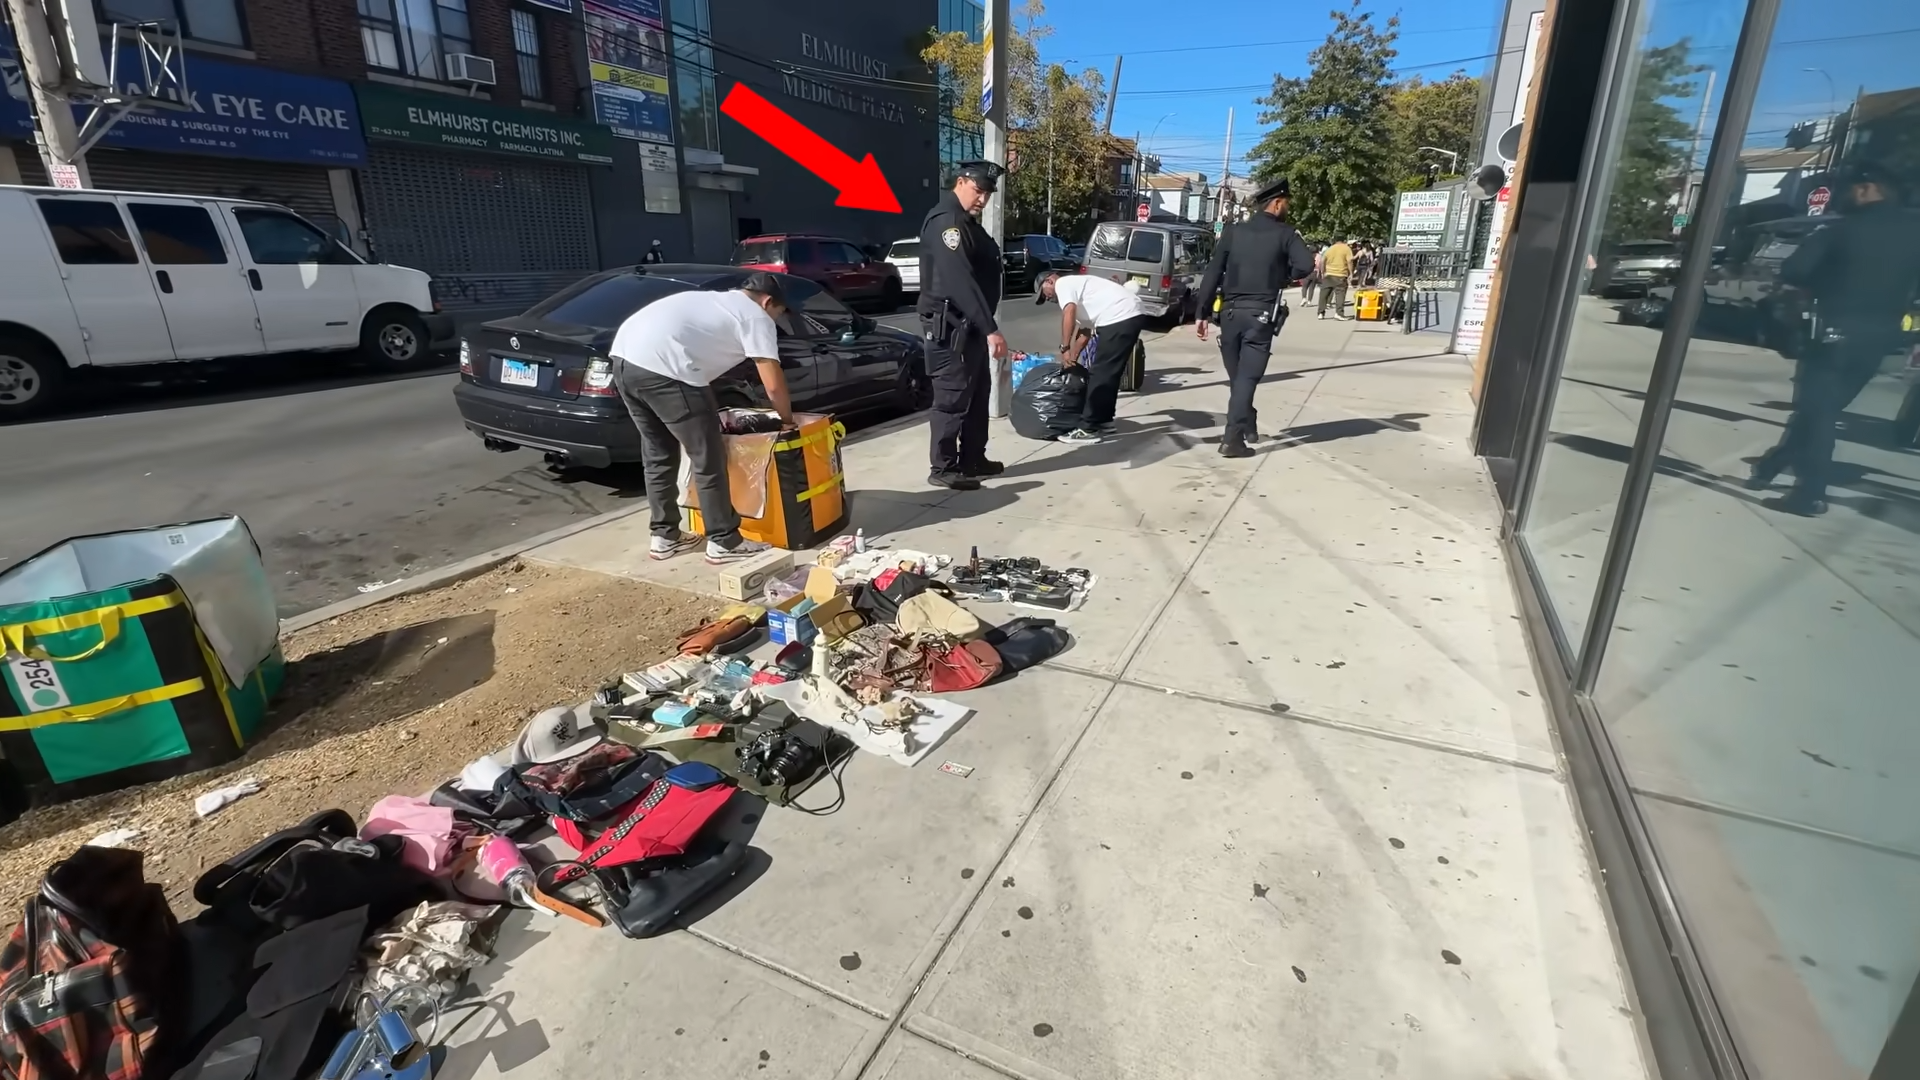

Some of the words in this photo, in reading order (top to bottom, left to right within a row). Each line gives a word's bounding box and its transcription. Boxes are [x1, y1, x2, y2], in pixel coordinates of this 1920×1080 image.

[801, 32, 889, 79] ELMHURST
[212, 93, 266, 120] EYE
[275, 102, 350, 130] CARE
[782, 74, 857, 112] MEDICAL
[862, 95, 905, 124] PLAZA
[171, 120, 179, 128] &
[182, 120, 230, 133] SURGERY
[234, 126, 247, 135] OF
[252, 128, 270, 138] THE
[272, 130, 290, 140] EYE
[407, 106, 488, 133] ELMHURST
[492, 121, 558, 143] CHEMISTS
[560, 132, 585, 147] INC.
[442, 134, 488, 147] PHARMACY
[500, 141, 538, 154] FARMACIA
[539, 146, 564, 157] LATINA
